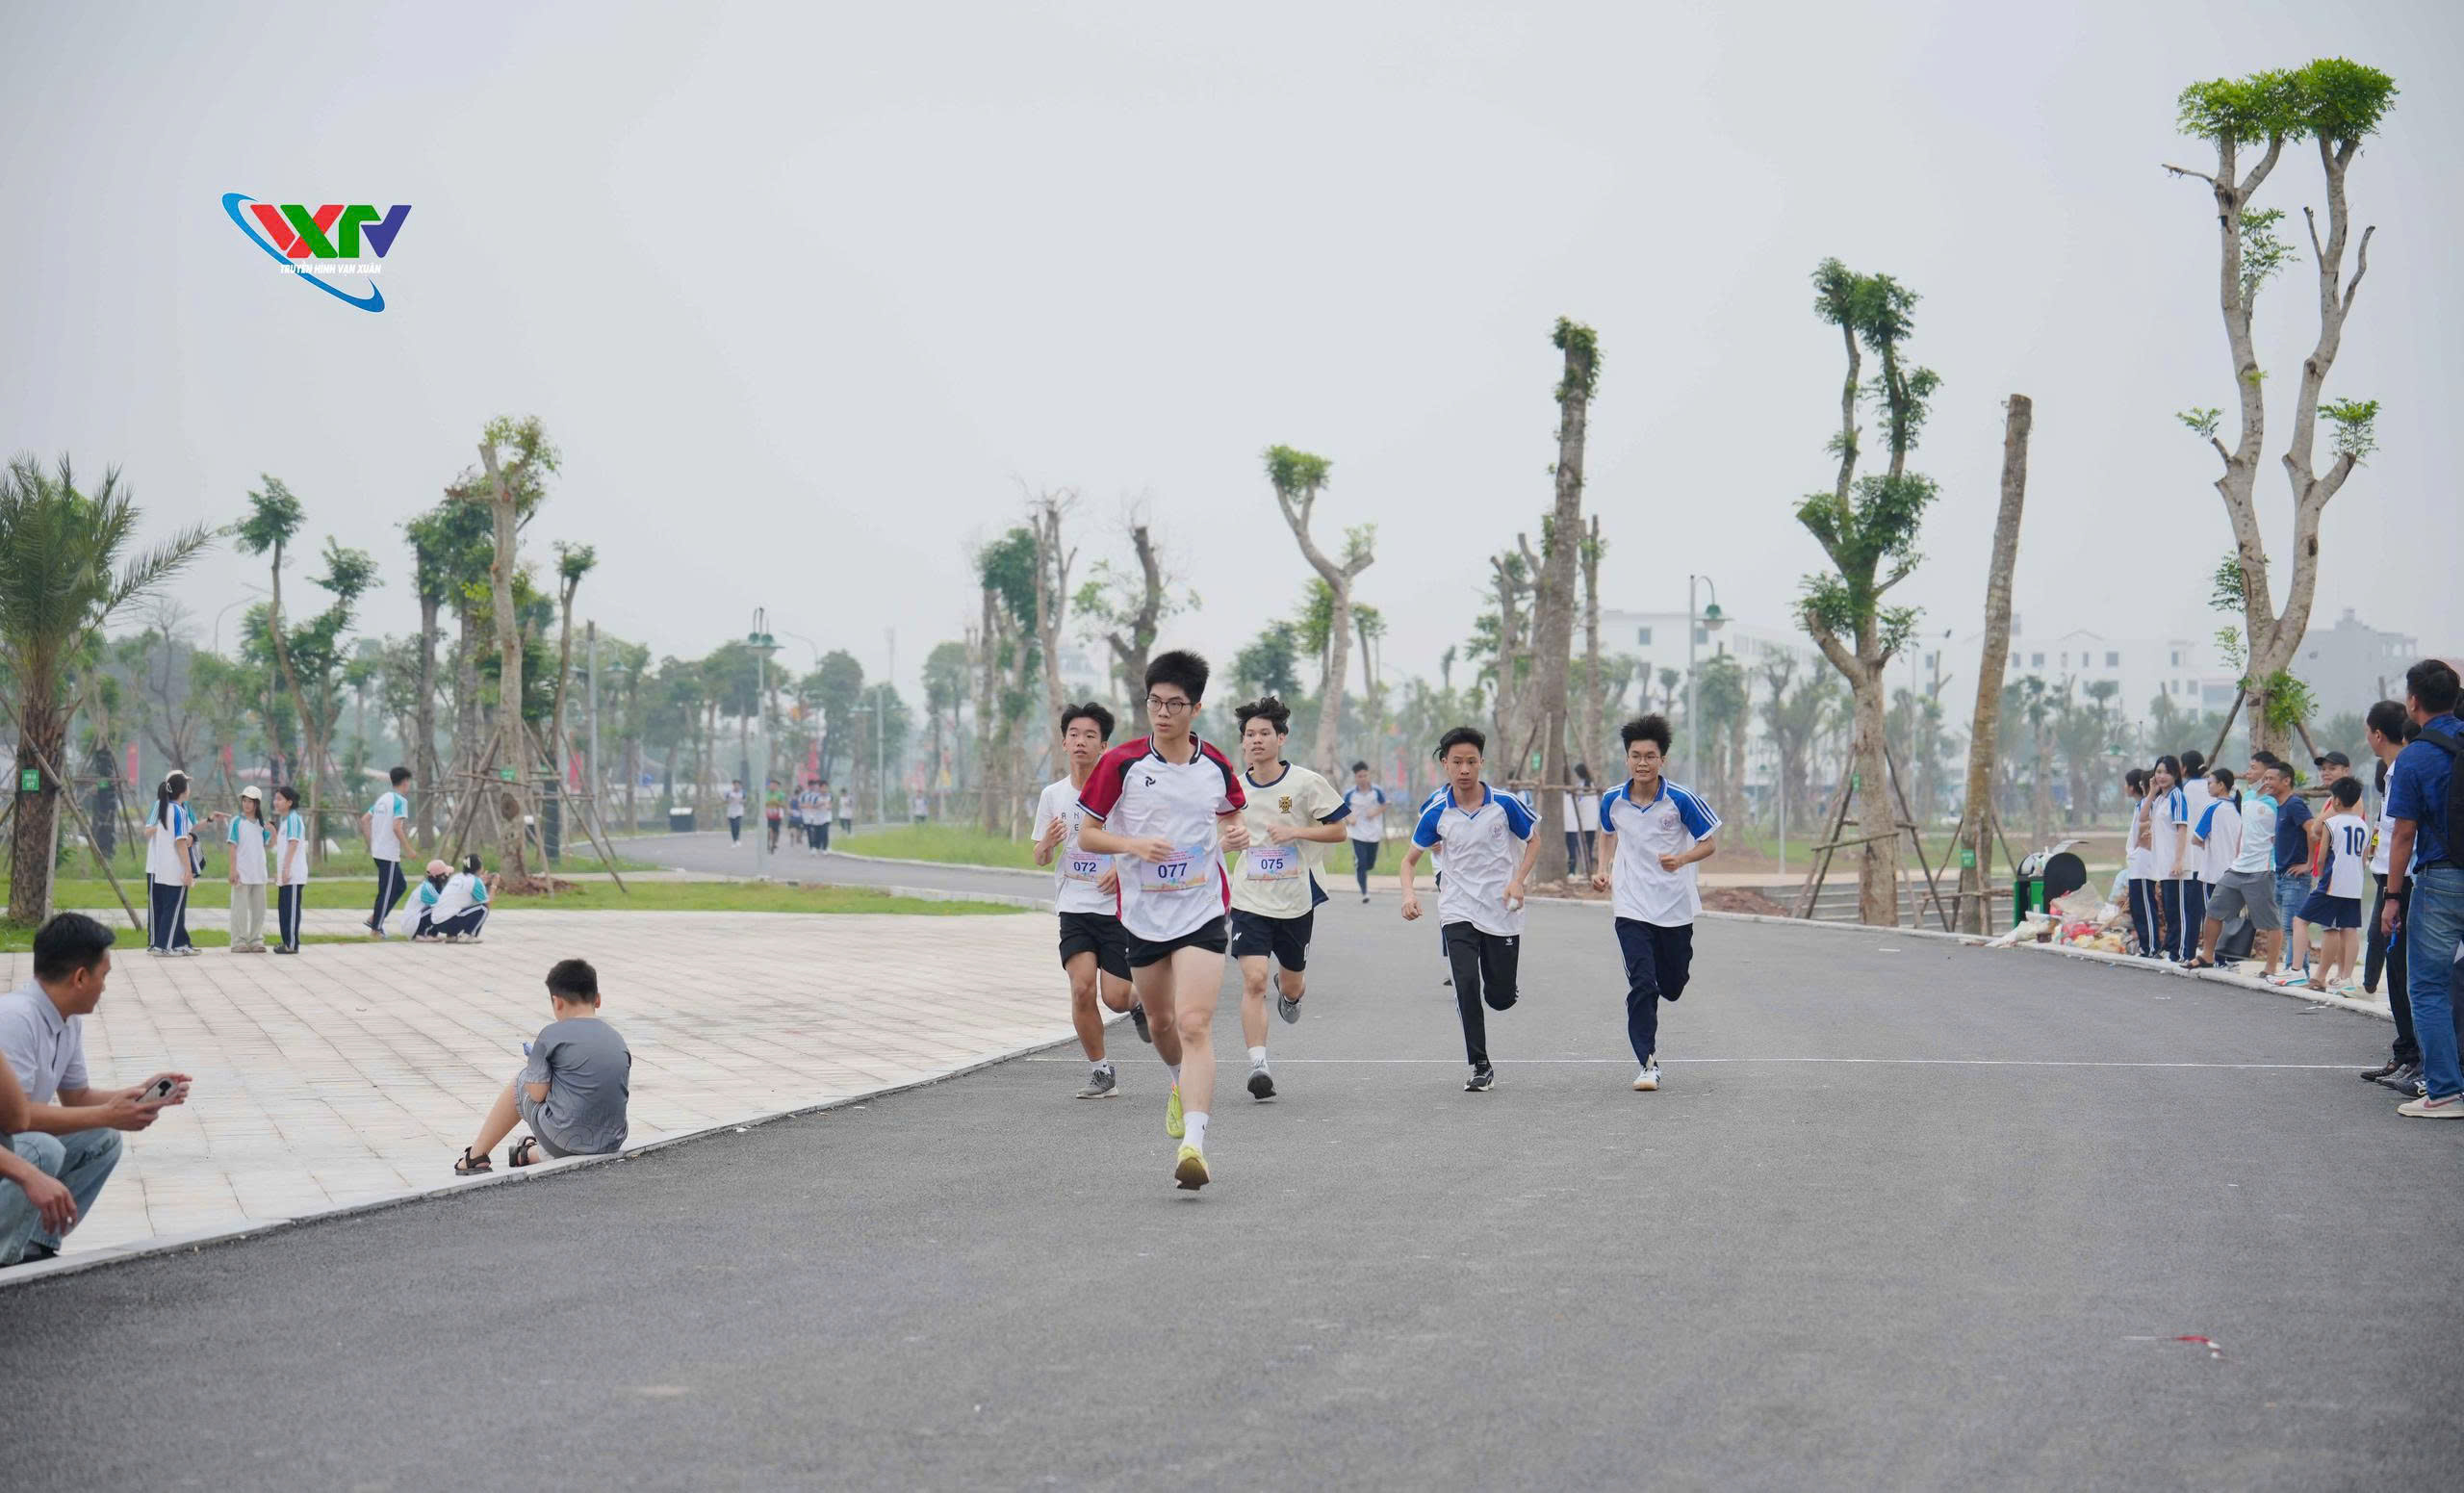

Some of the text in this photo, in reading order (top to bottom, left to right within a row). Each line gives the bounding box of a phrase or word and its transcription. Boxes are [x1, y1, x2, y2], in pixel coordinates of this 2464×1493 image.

[2343, 826, 2365, 857] 10
[1073, 862, 1096, 872] 072
[1158, 862, 1188, 879] 077
[1261, 859, 1284, 869] 075
